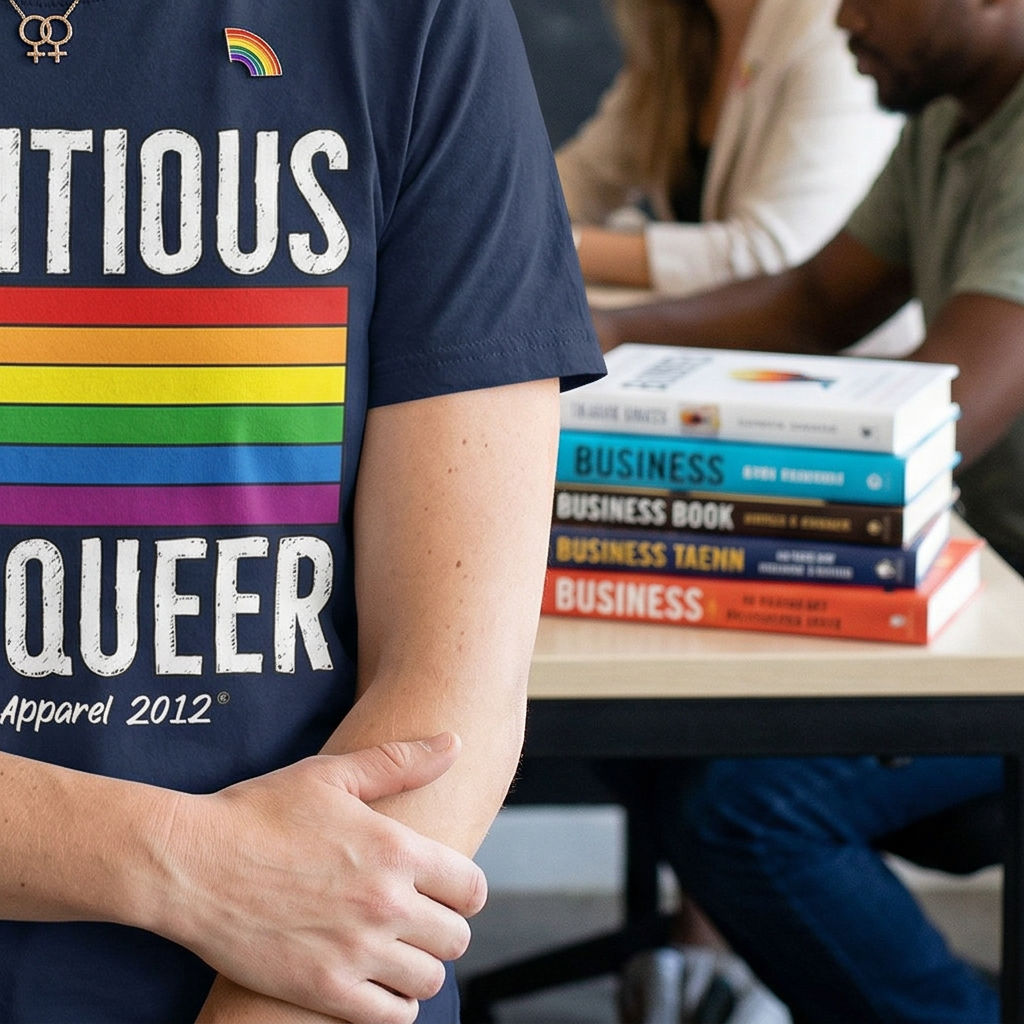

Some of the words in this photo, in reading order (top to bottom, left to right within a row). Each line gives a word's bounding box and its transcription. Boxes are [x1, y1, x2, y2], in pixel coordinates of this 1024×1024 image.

[575, 445, 725, 486] BUSINESS
[556, 491, 667, 526] BUSINESS
[671, 499, 735, 531] BOOK
[556, 535, 667, 568] BUSINESS
[4, 537, 334, 677] QUEER
[555, 576, 705, 622] BUSINESS
